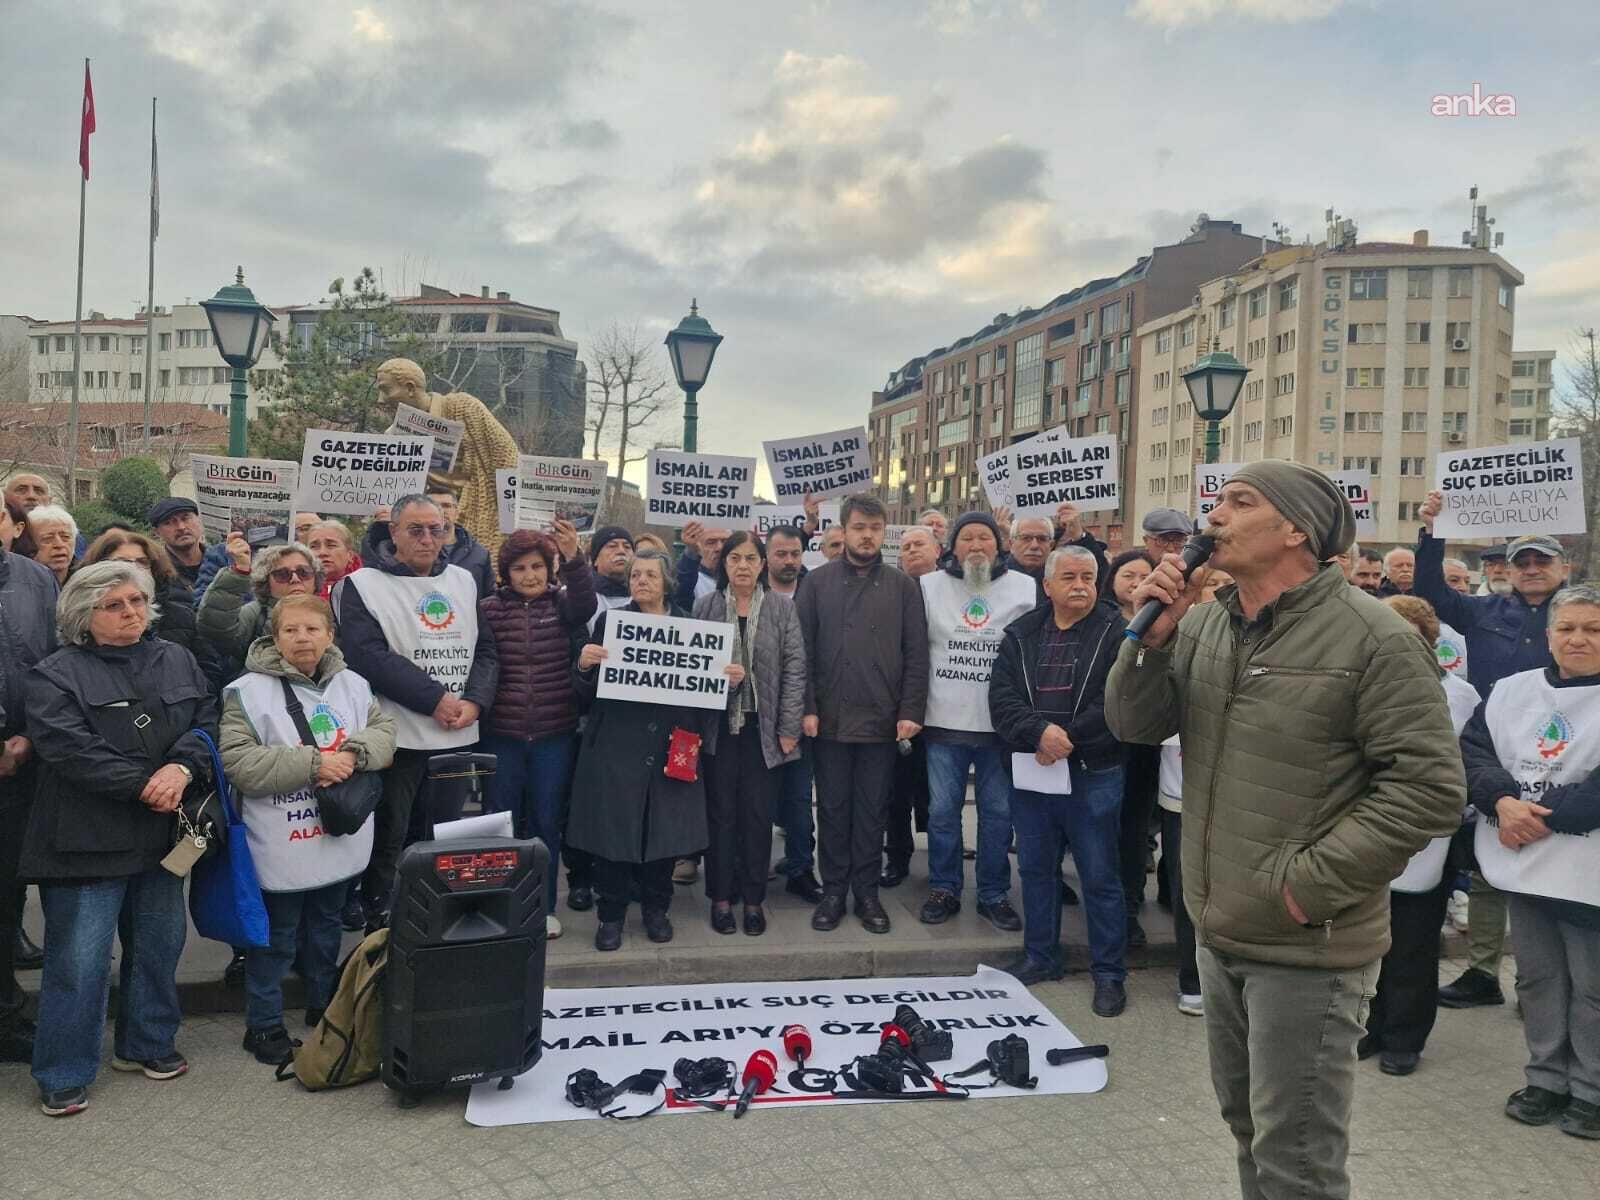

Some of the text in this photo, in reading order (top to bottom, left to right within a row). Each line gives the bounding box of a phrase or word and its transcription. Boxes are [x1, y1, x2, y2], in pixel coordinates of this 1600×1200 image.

[1321, 274, 1342, 374] GÖKSU
[321, 440, 424, 457] GAZETECİLİK
[772, 437, 860, 462] İSMAİL ARI
[1017, 446, 1110, 470] İSMAİL ARI
[311, 455, 426, 472] SUÇ DEĞİLDİR!
[655, 459, 748, 481] İSMAİL ARI
[783, 456, 854, 479] SERBEST
[1448, 447, 1566, 473] GAZETECİLİK
[314, 471, 367, 488] İSMAİL
[776, 468, 870, 496] BIRAKILSIN!
[1026, 465, 1104, 487] SERBEST
[1442, 466, 1573, 490] SUÇ DEĞİLDİR!
[247, 491, 290, 502] yazacağız
[320, 488, 400, 505] ÖZGÜRLÜ
[662, 481, 739, 499] SERBEST
[1016, 483, 1116, 507] BIRAKILSIN!
[1447, 488, 1568, 509] İSMAİL ARI'YA
[649, 498, 750, 518] BIRAKILSIN!
[1457, 506, 1559, 526] ÖZGÜRLÜK!
[616, 620, 724, 650] İSMAİL ARI
[948, 639, 1000, 652] EMEKLİYİZ
[414, 646, 470, 660] EMEKLİYİZ
[622, 647, 713, 671] SERBEST
[604, 667, 726, 694] BIRAKILSIN!
[936, 668, 991, 682] KAZANACA
[542, 988, 1010, 1019] AZETECİLİK SUÇ DEĞİLDİR
[542, 1031, 647, 1050] MAİL
